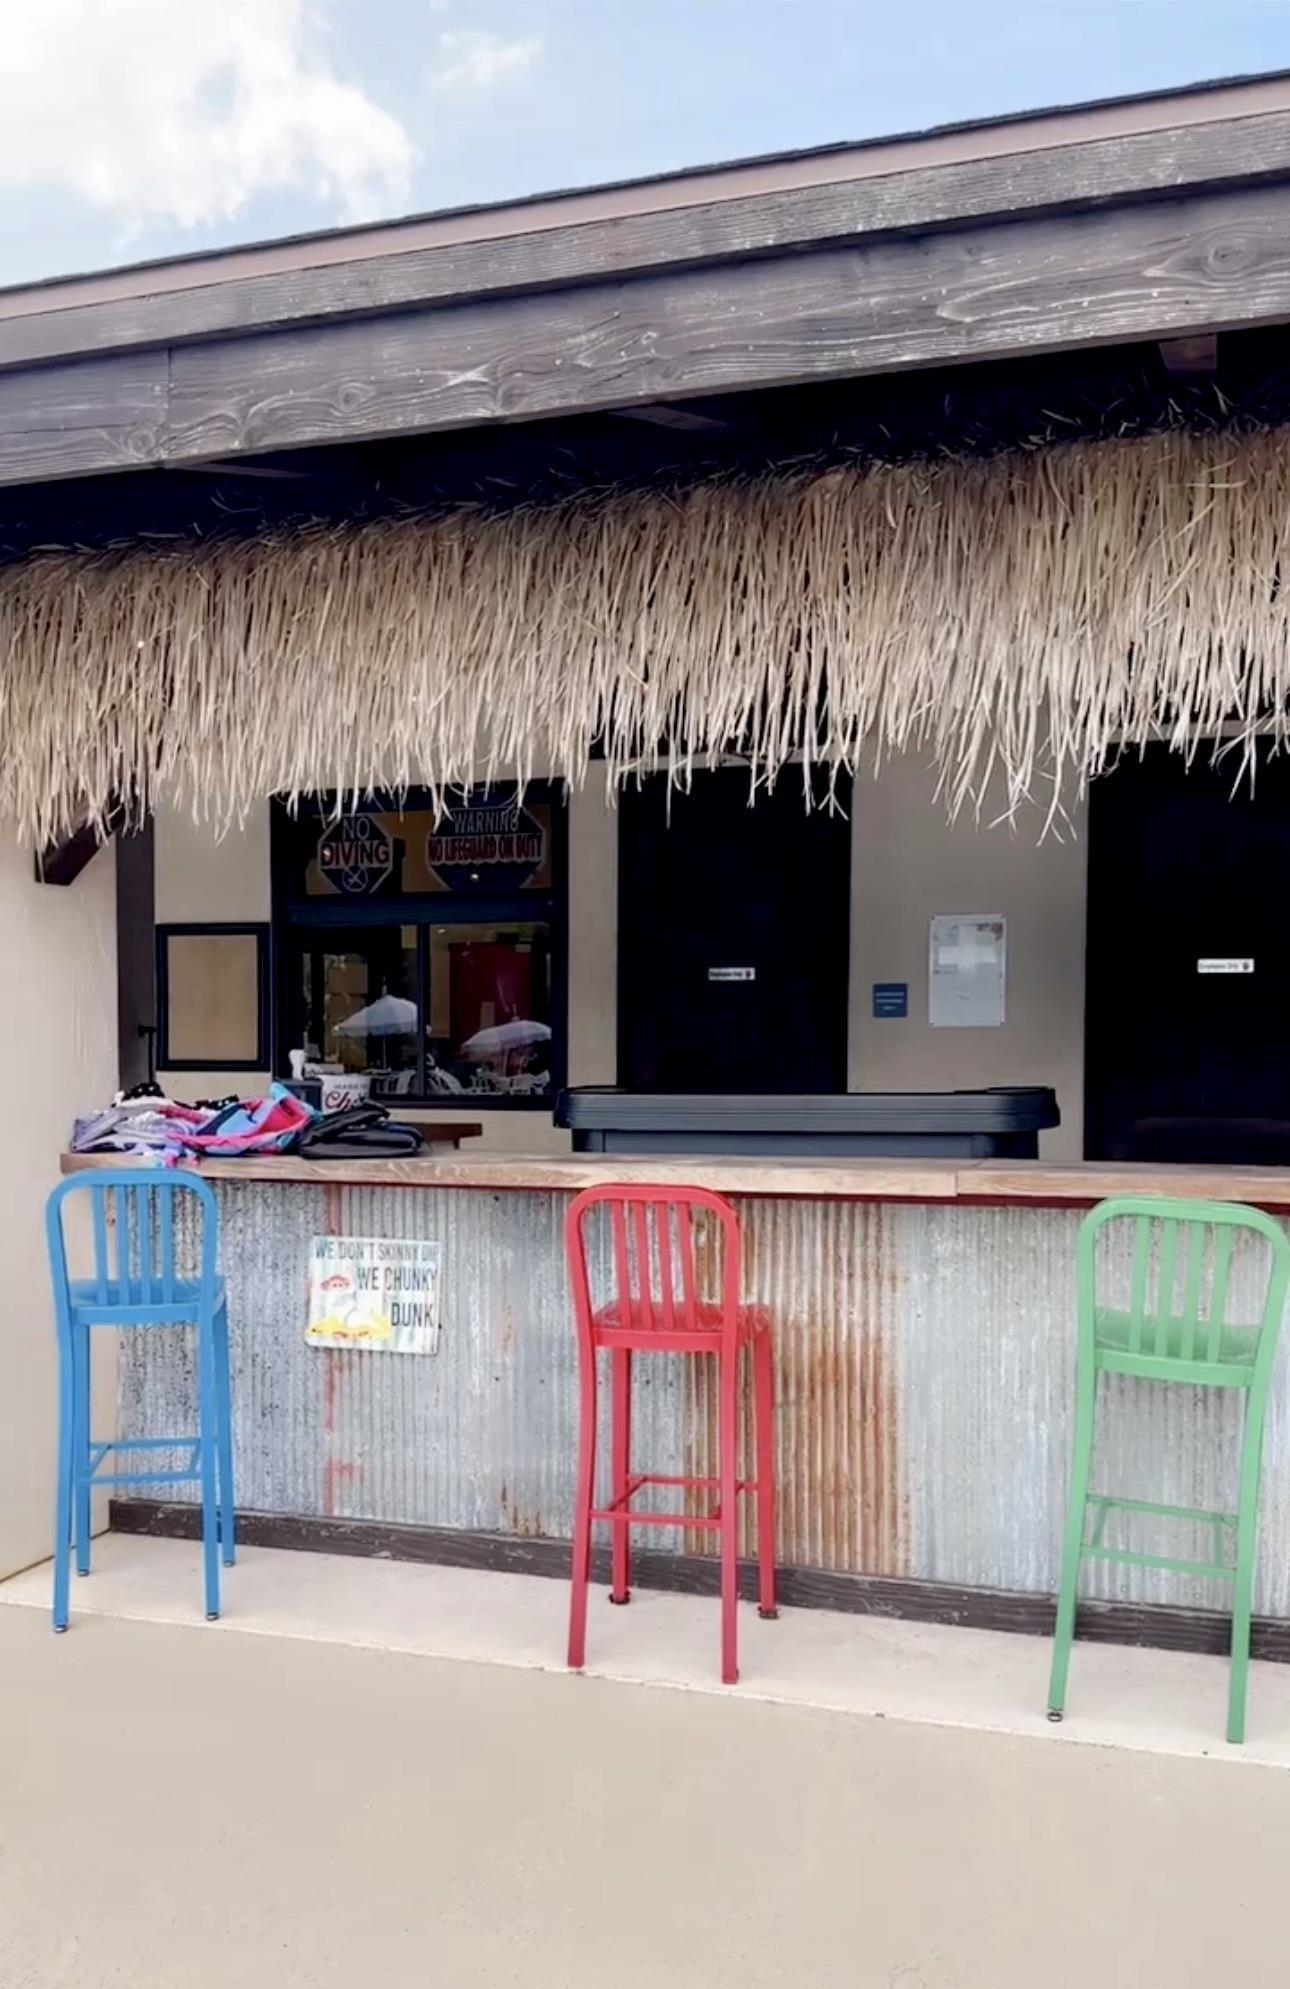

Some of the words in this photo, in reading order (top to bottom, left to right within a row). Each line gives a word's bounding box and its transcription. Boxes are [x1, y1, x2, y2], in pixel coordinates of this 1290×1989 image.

[343, 817, 370, 840] NO
[453, 809, 519, 833] WARNING
[321, 841, 390, 866] DIVING
[498, 835, 514, 859] ON
[314, 1240, 334, 1260] WE
[338, 1241, 375, 1261] DON'T
[378, 1242, 419, 1261] SKINNY
[357, 1266, 379, 1291] WE
[384, 1266, 438, 1292] CHUNKY
[391, 1302, 434, 1327] DUNK
